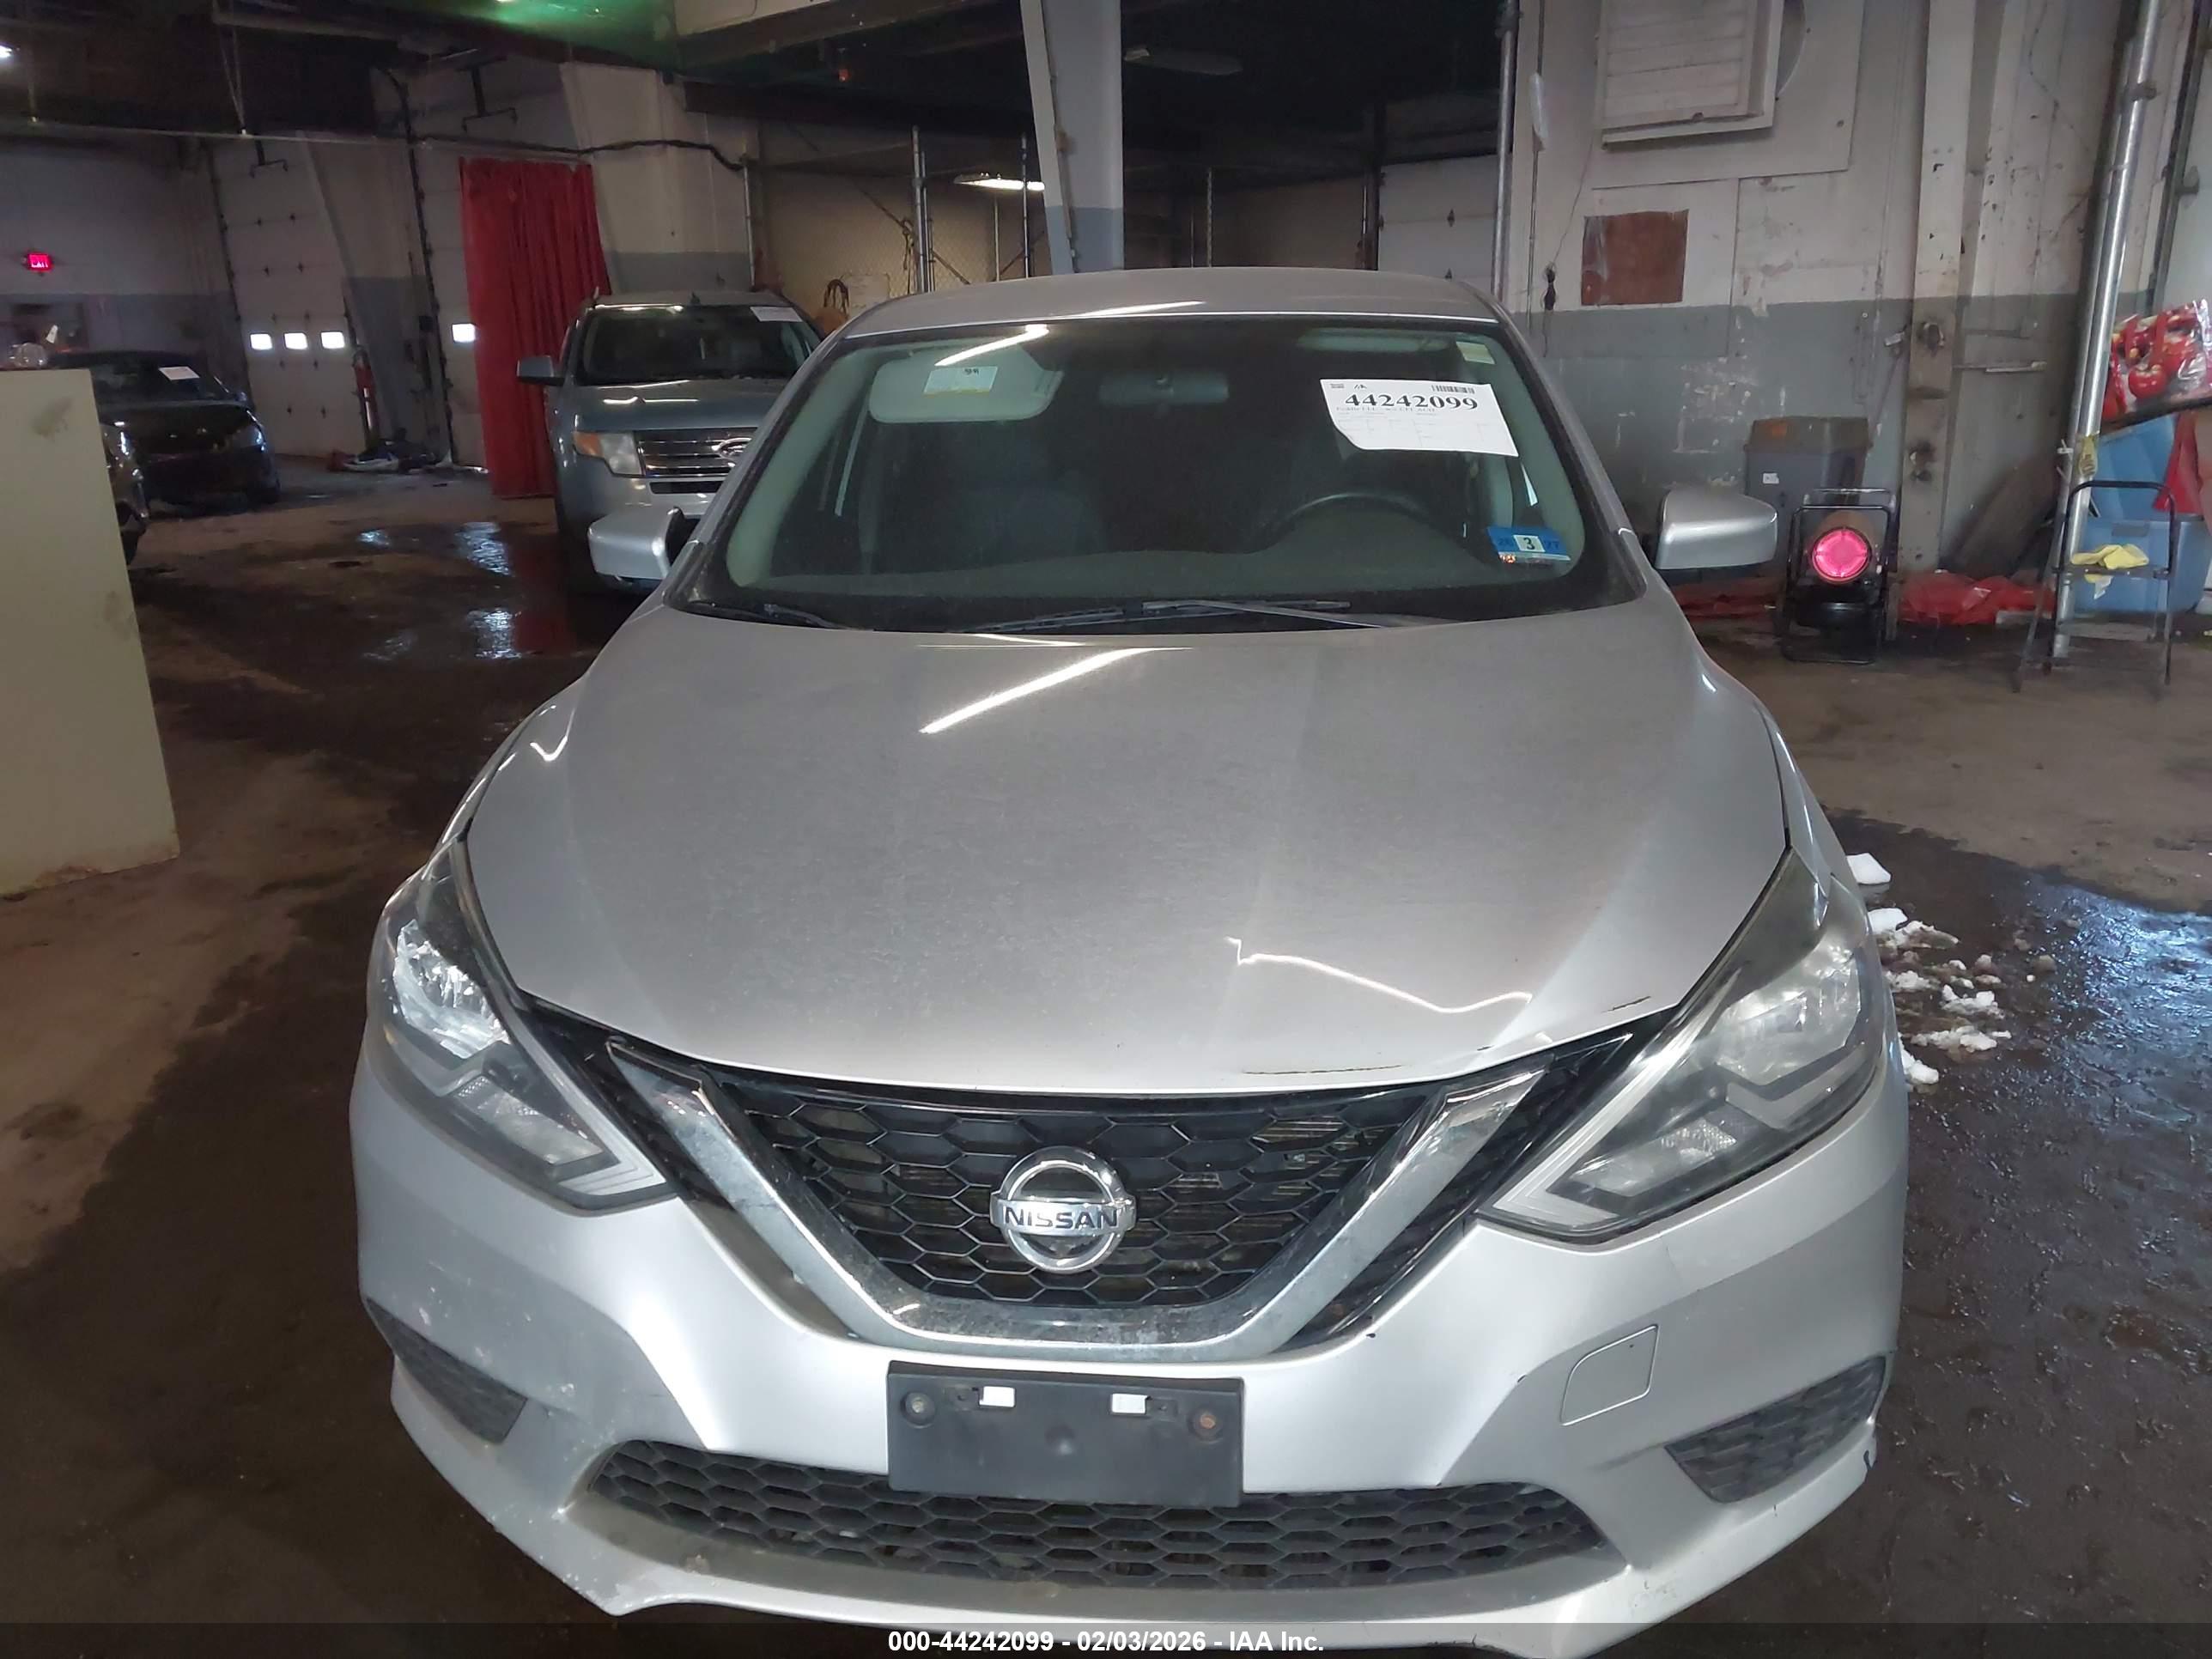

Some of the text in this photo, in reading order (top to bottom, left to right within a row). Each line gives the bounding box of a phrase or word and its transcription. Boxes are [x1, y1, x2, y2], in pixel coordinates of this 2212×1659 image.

[1345, 393, 1478, 410] 44242099
[1522, 537, 1535, 550] 3
[1003, 1206, 1120, 1230] NISSAN
